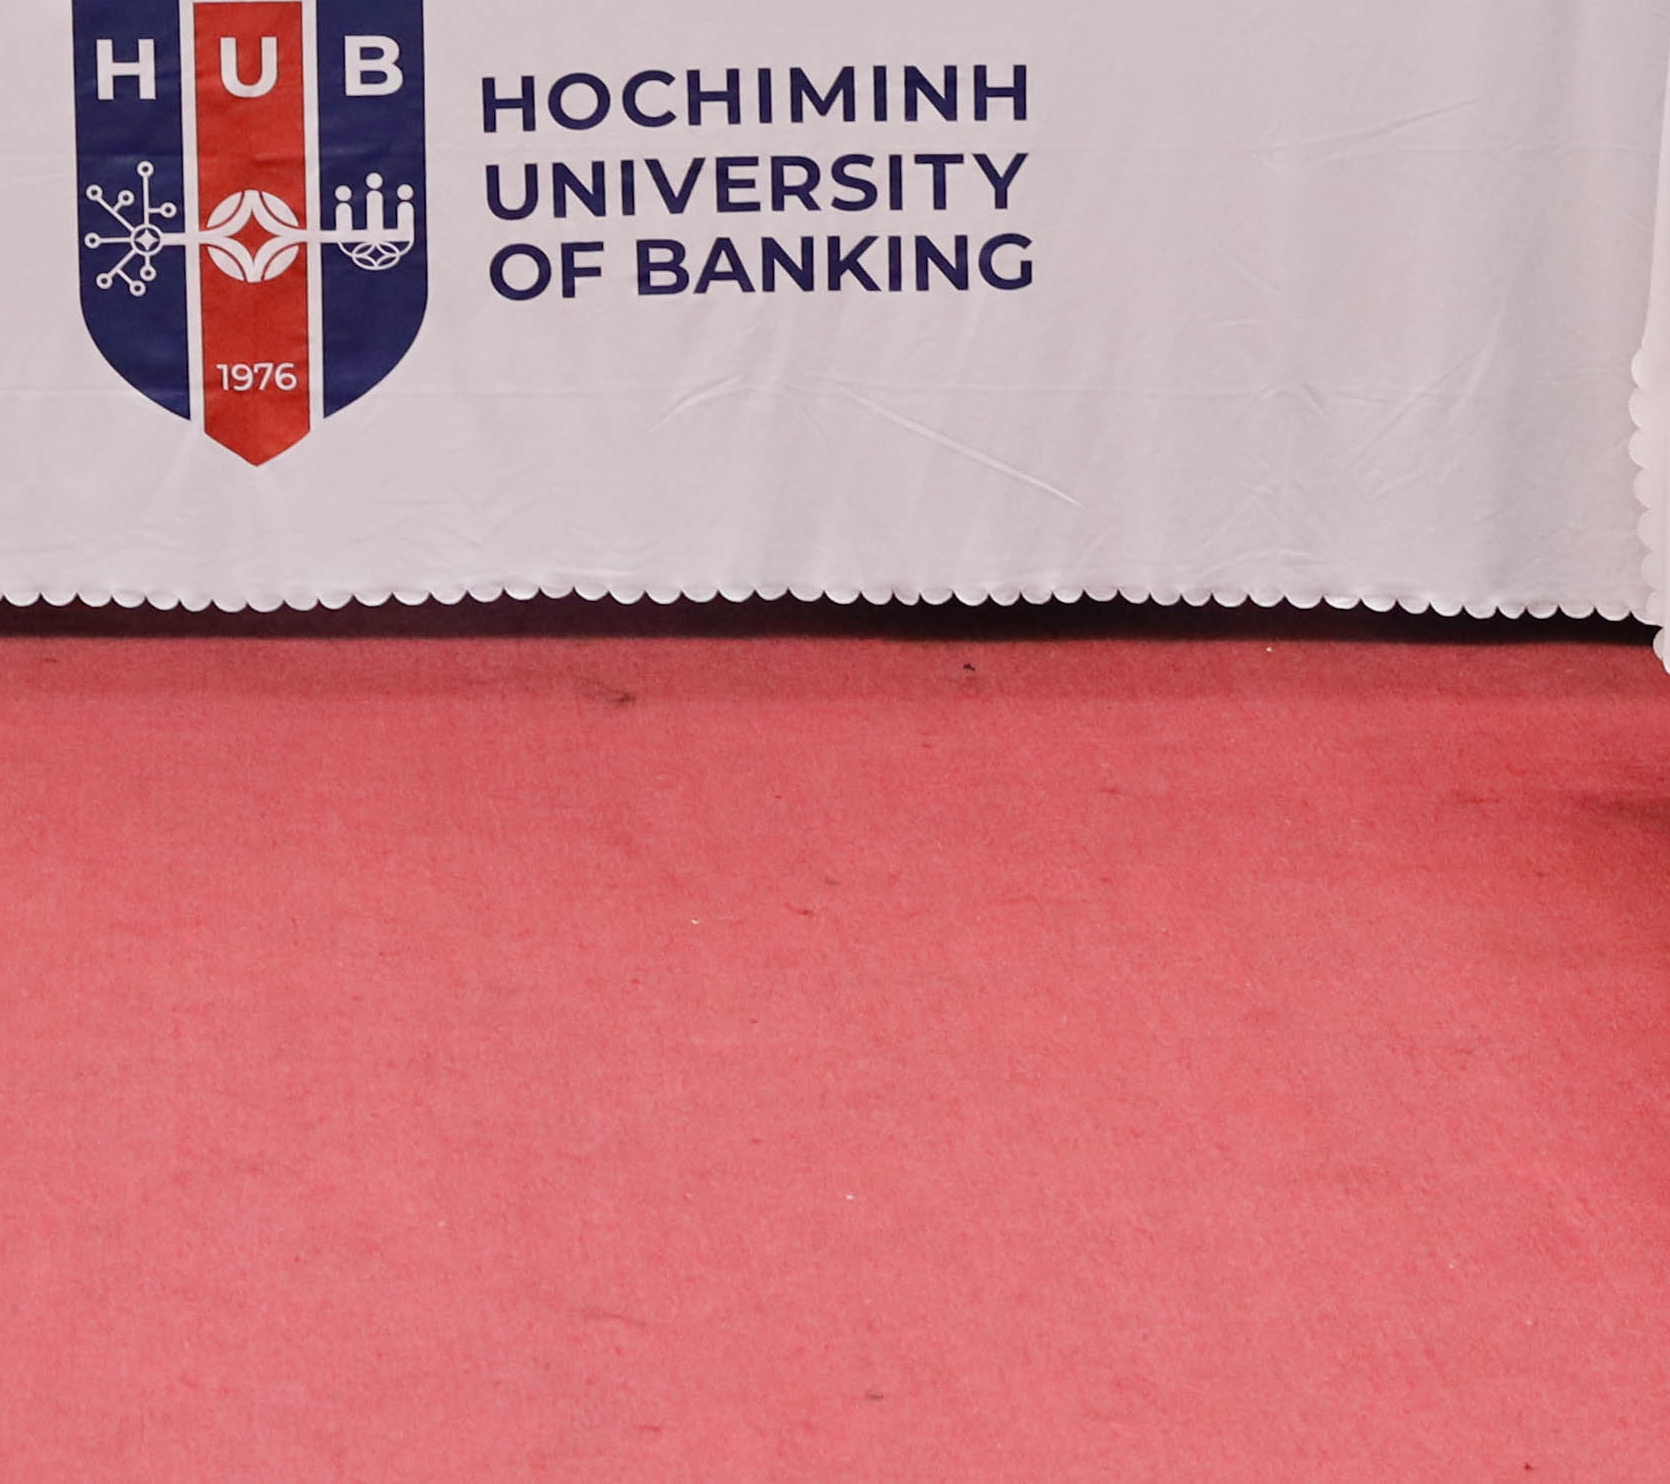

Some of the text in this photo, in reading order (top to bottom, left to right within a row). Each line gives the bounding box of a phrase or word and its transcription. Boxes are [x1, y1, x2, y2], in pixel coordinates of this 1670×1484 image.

[95, 34, 405, 103] HUB
[480, 63, 1028, 134] HOCHIMINH
[486, 152, 1029, 221] UNIVERSITY
[488, 233, 1034, 302] OF BANKING
[216, 361, 298, 394] 1976
